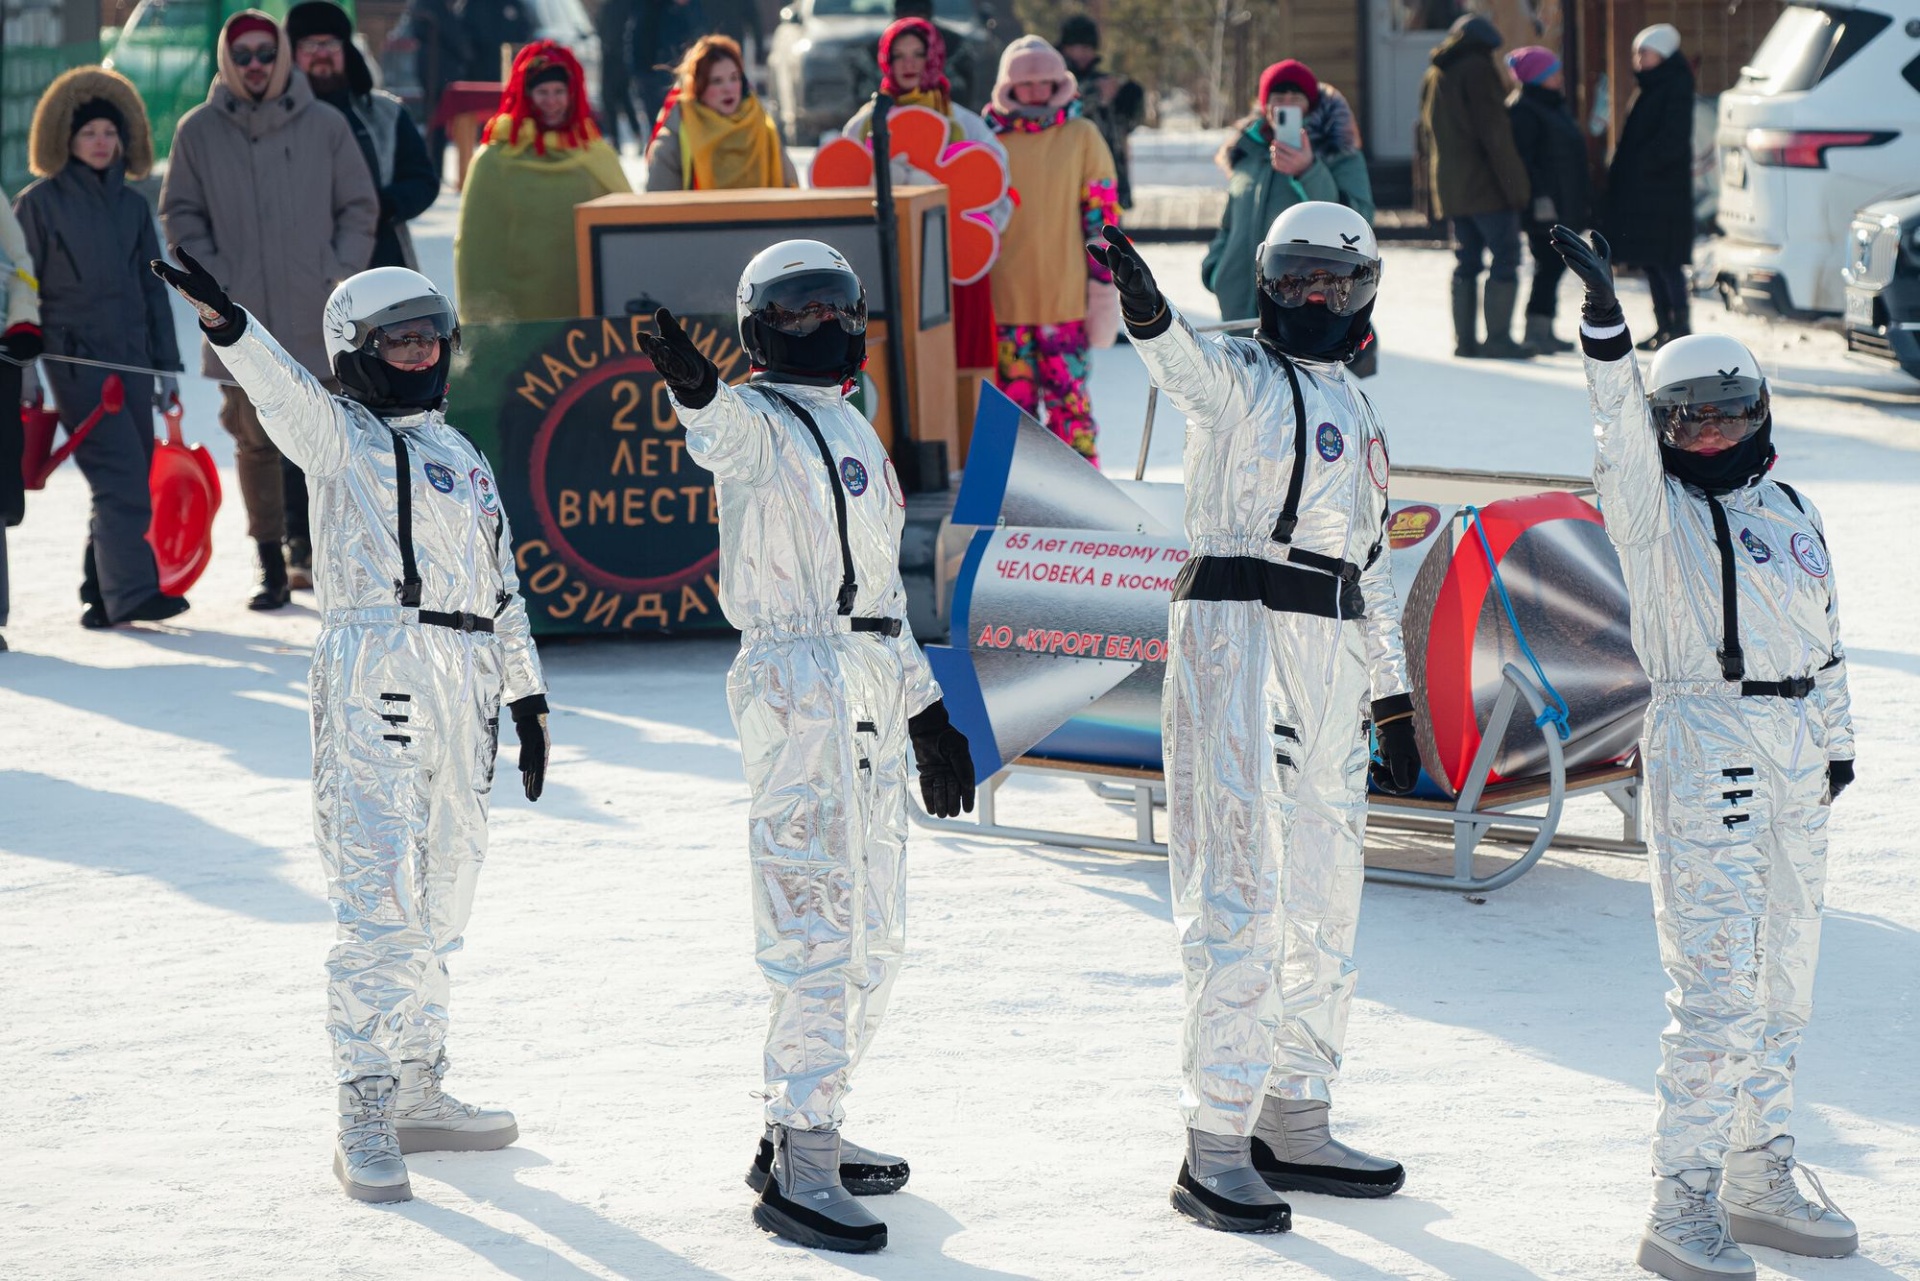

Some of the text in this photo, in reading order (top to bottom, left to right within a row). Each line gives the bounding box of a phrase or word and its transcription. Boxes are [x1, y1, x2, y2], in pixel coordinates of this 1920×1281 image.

[612, 380, 679, 431] 20
[611, 439, 687, 477] ЛЕТ
[1005, 533, 1031, 549] 65
[1032, 538, 1067, 553] лет
[1069, 540, 1160, 563] первому
[997, 560, 1095, 586] ЧЕЛОВЕКА
[977, 625, 1013, 648] АО
[1016, 629, 1103, 656] «КУРОРТ
